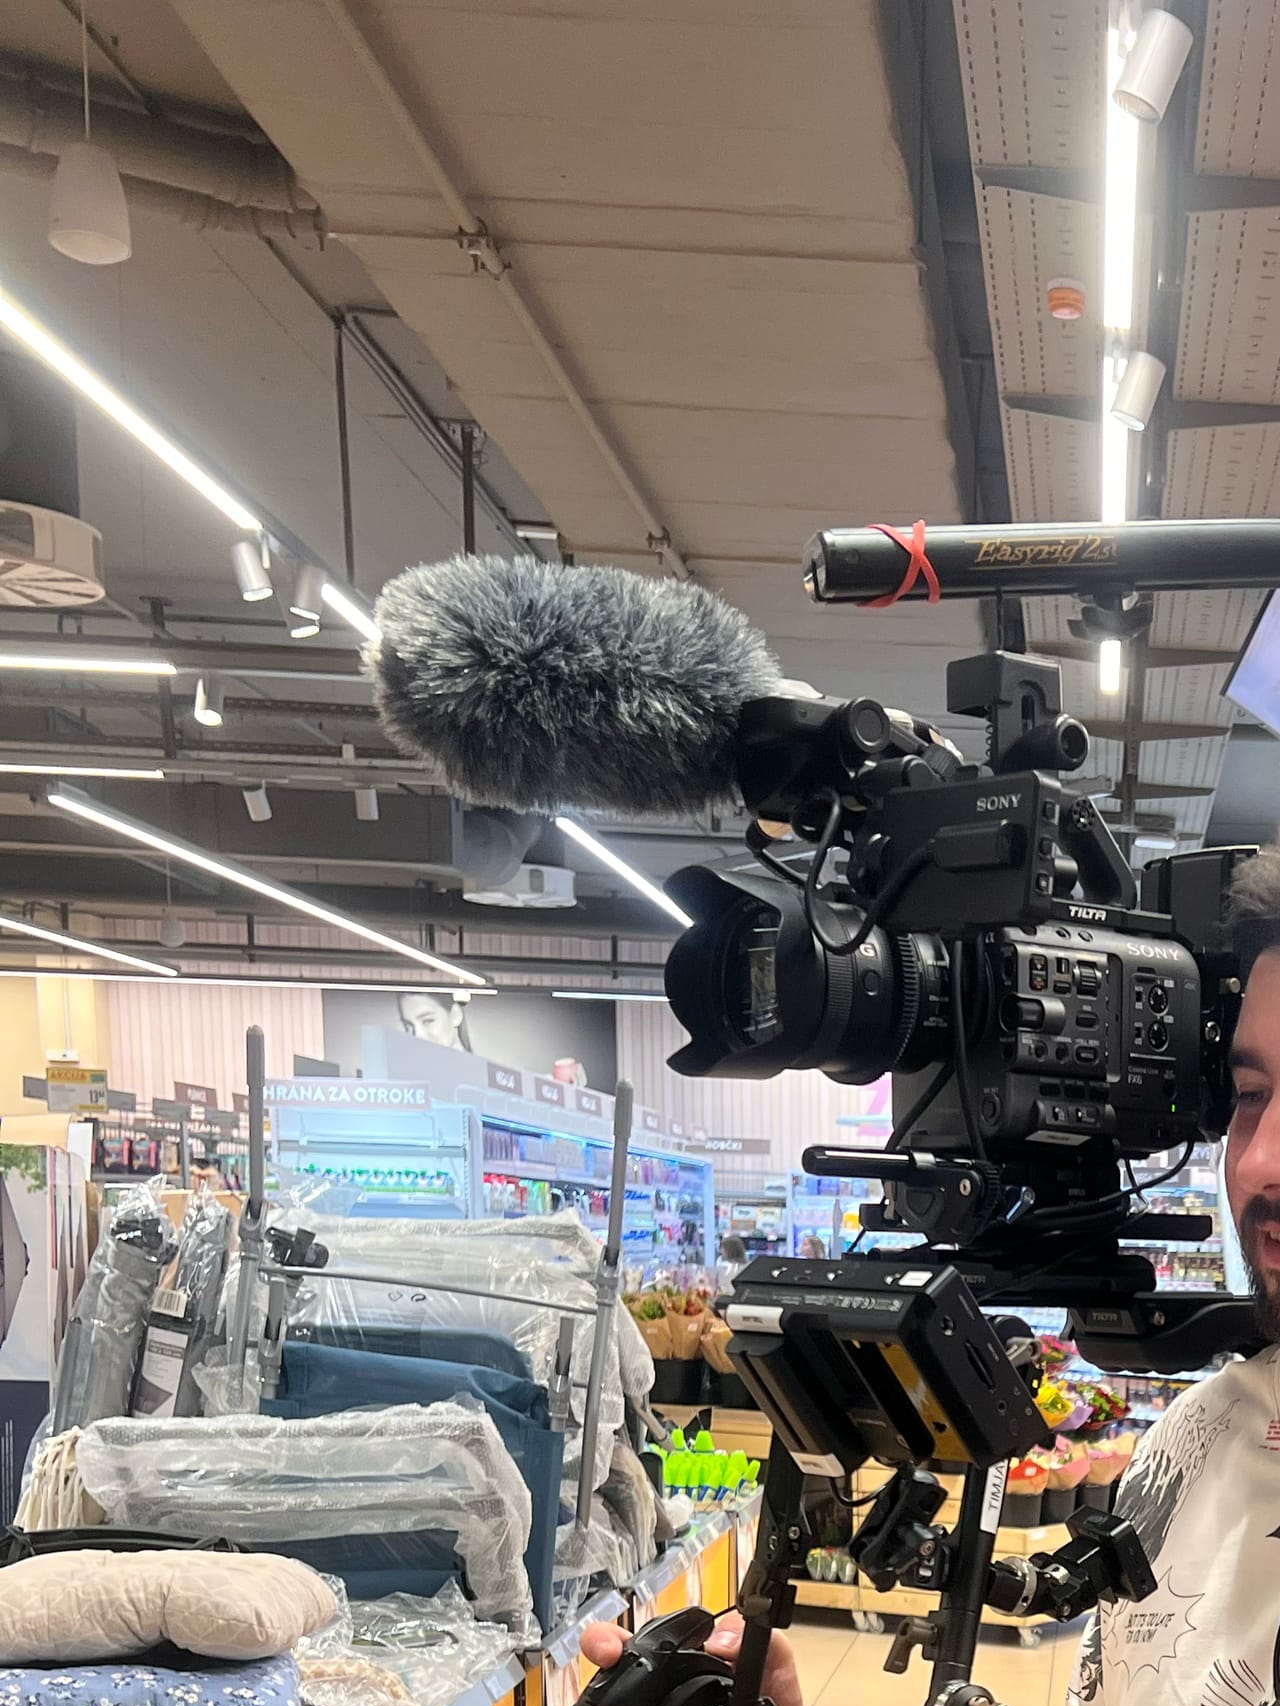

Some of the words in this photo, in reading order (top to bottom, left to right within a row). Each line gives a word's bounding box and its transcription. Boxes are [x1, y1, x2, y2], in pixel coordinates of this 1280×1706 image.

[974, 539, 1079, 565] Easyrig
[976, 793, 1022, 812] SONY
[1068, 905, 1107, 921] TILTA
[1126, 942, 1180, 961] SONY
[1127, 1074, 1143, 1085] FX6
[263, 1084, 325, 1101] HRANA
[328, 1086, 350, 1102] ZA
[355, 1086, 426, 1105] OTROKE
